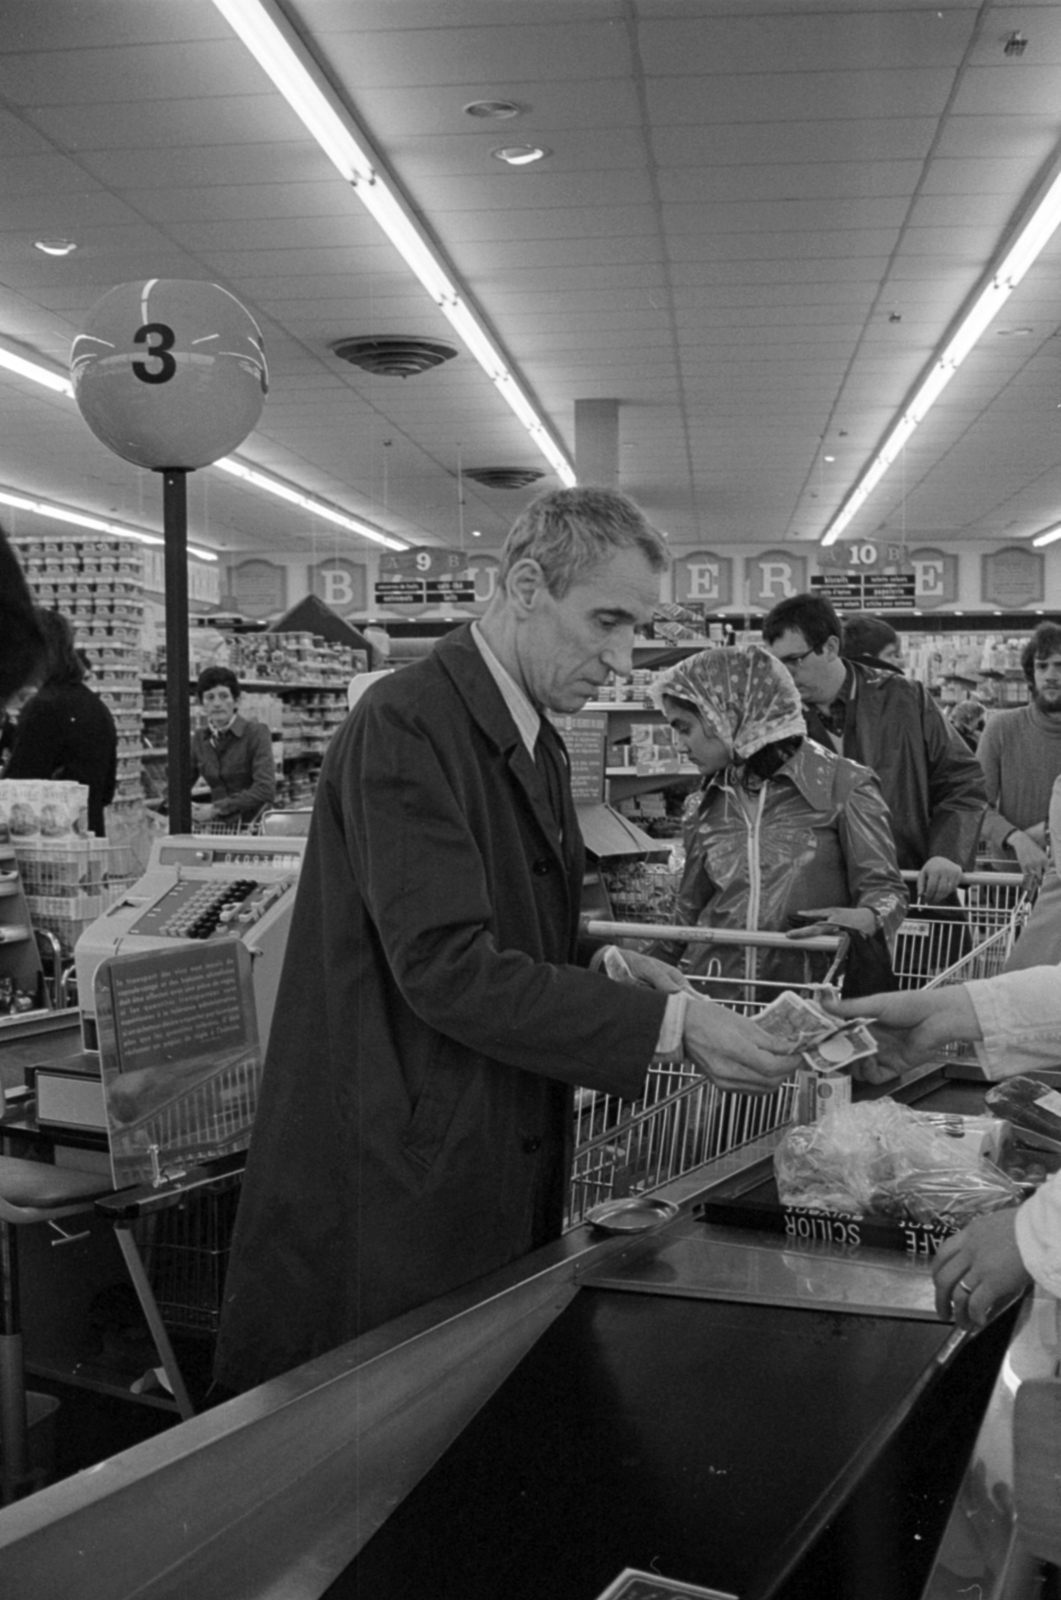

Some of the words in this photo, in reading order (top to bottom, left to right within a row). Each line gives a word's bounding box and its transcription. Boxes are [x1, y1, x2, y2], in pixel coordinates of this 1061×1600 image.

[132, 322, 177, 384] 3
[416, 552, 430, 572] 9
[850, 545, 878, 565] 10
[784, 1214, 861, 1244] SCILIOR
[905, 1230, 944, 1254] AFE
